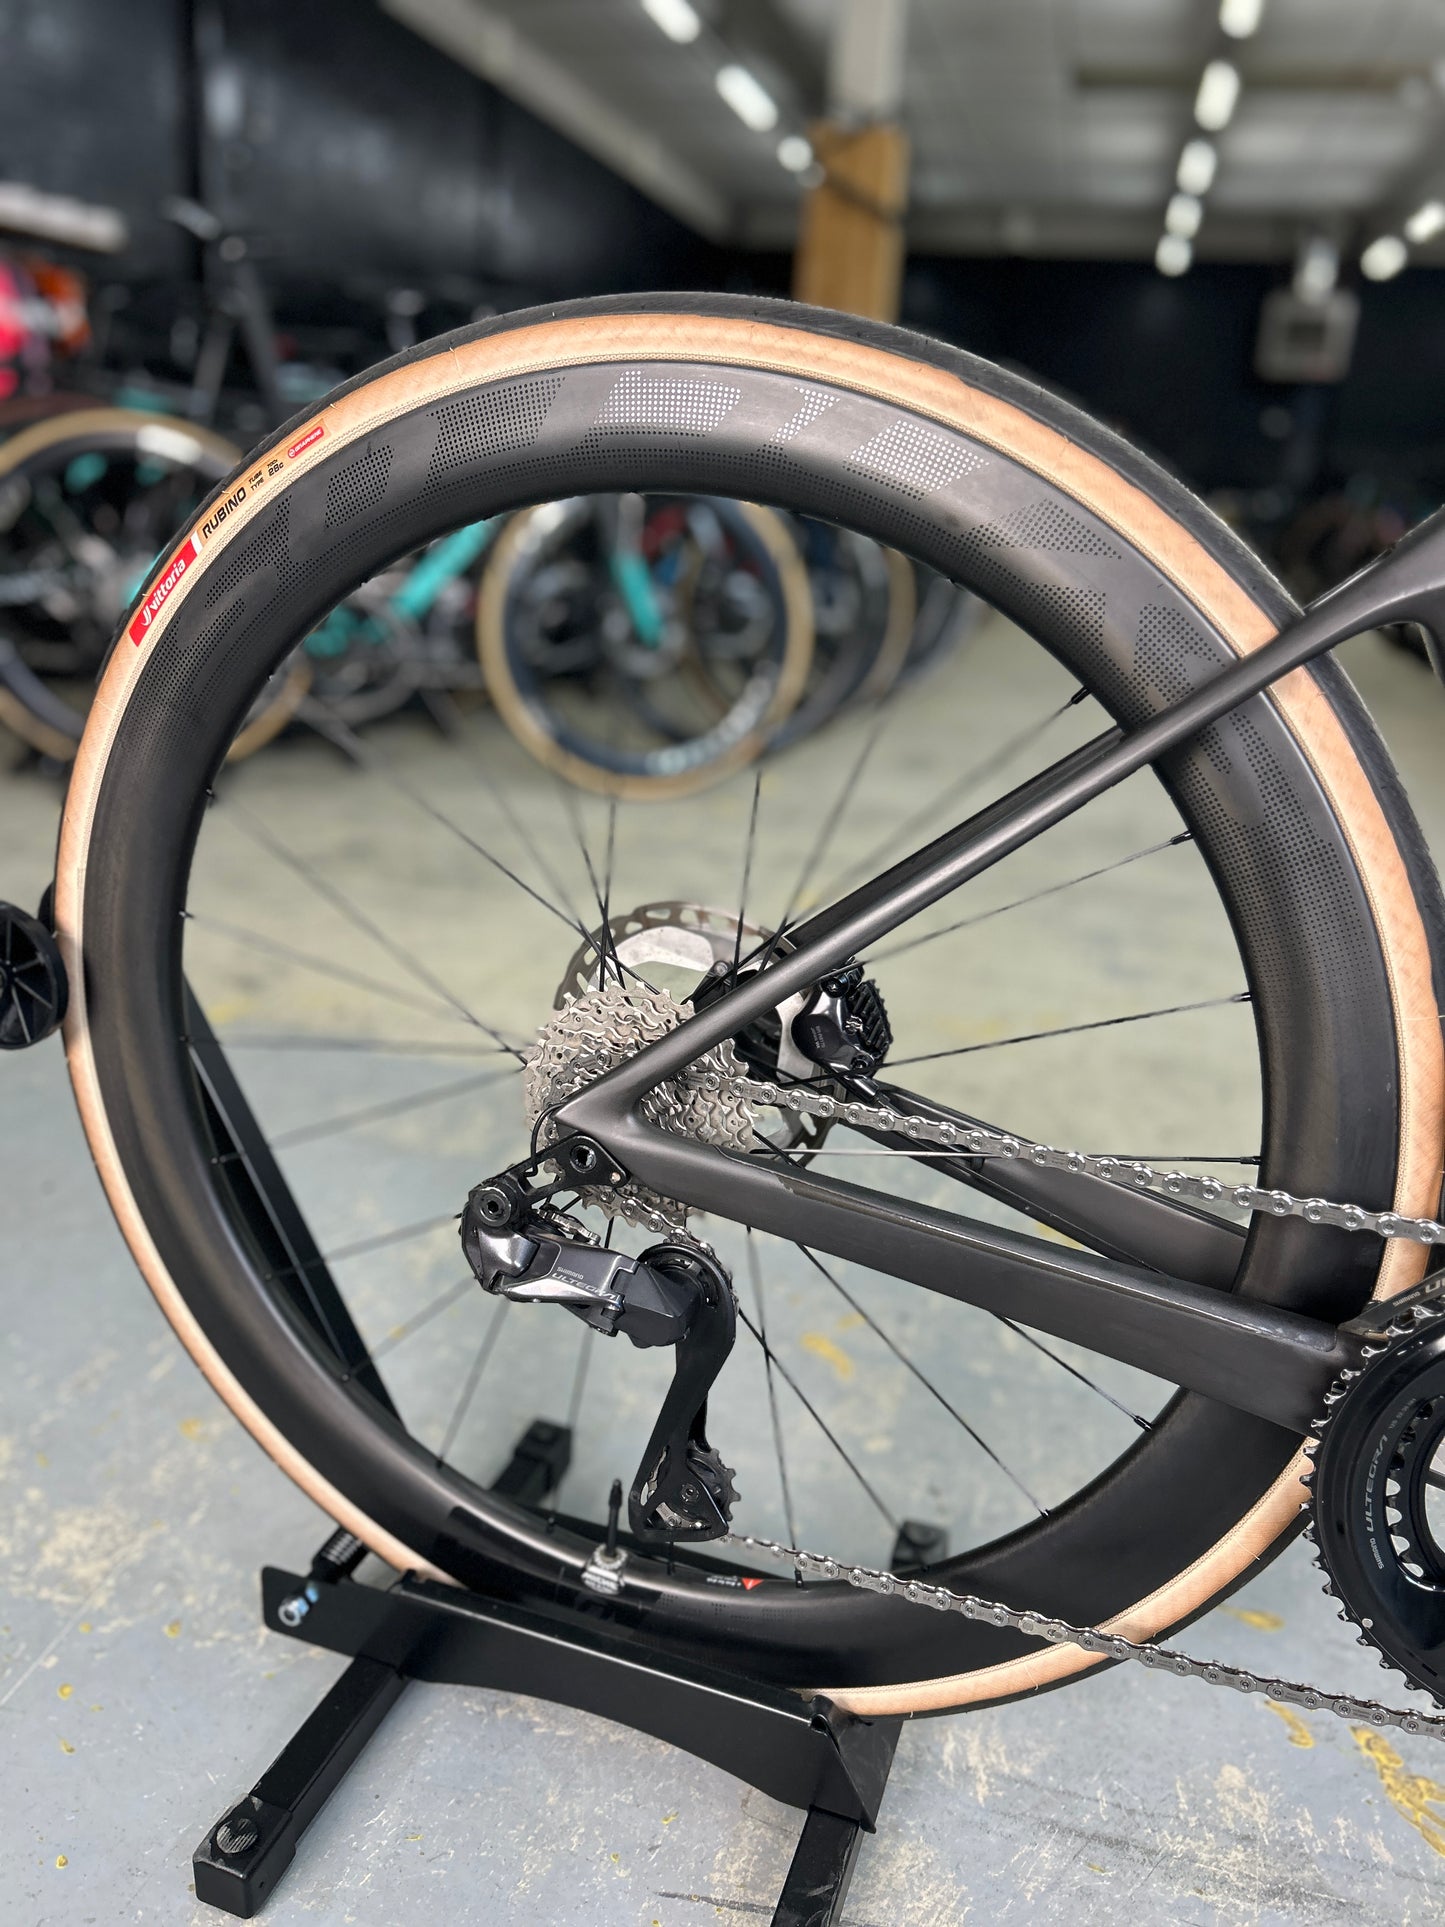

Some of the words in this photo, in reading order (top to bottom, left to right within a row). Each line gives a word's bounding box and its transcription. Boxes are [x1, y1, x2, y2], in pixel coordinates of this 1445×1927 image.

[294, 429, 322, 452] GRAPHENE
[248, 470, 263, 485] TUBE
[268, 462, 285, 476] 28c
[250, 477, 265, 491] TYPE
[202, 486, 247, 539] RUBINO
[149, 558, 186, 611] vittoria
[556, 1266, 584, 1280] SHIMANO
[552, 1272, 616, 1299] ULTEGRA
[1392, 1291, 1421, 1307] SHIMANO
[1365, 1434, 1388, 1532] ULTEGRA
[1369, 1537, 1385, 1570] SHIMANO
